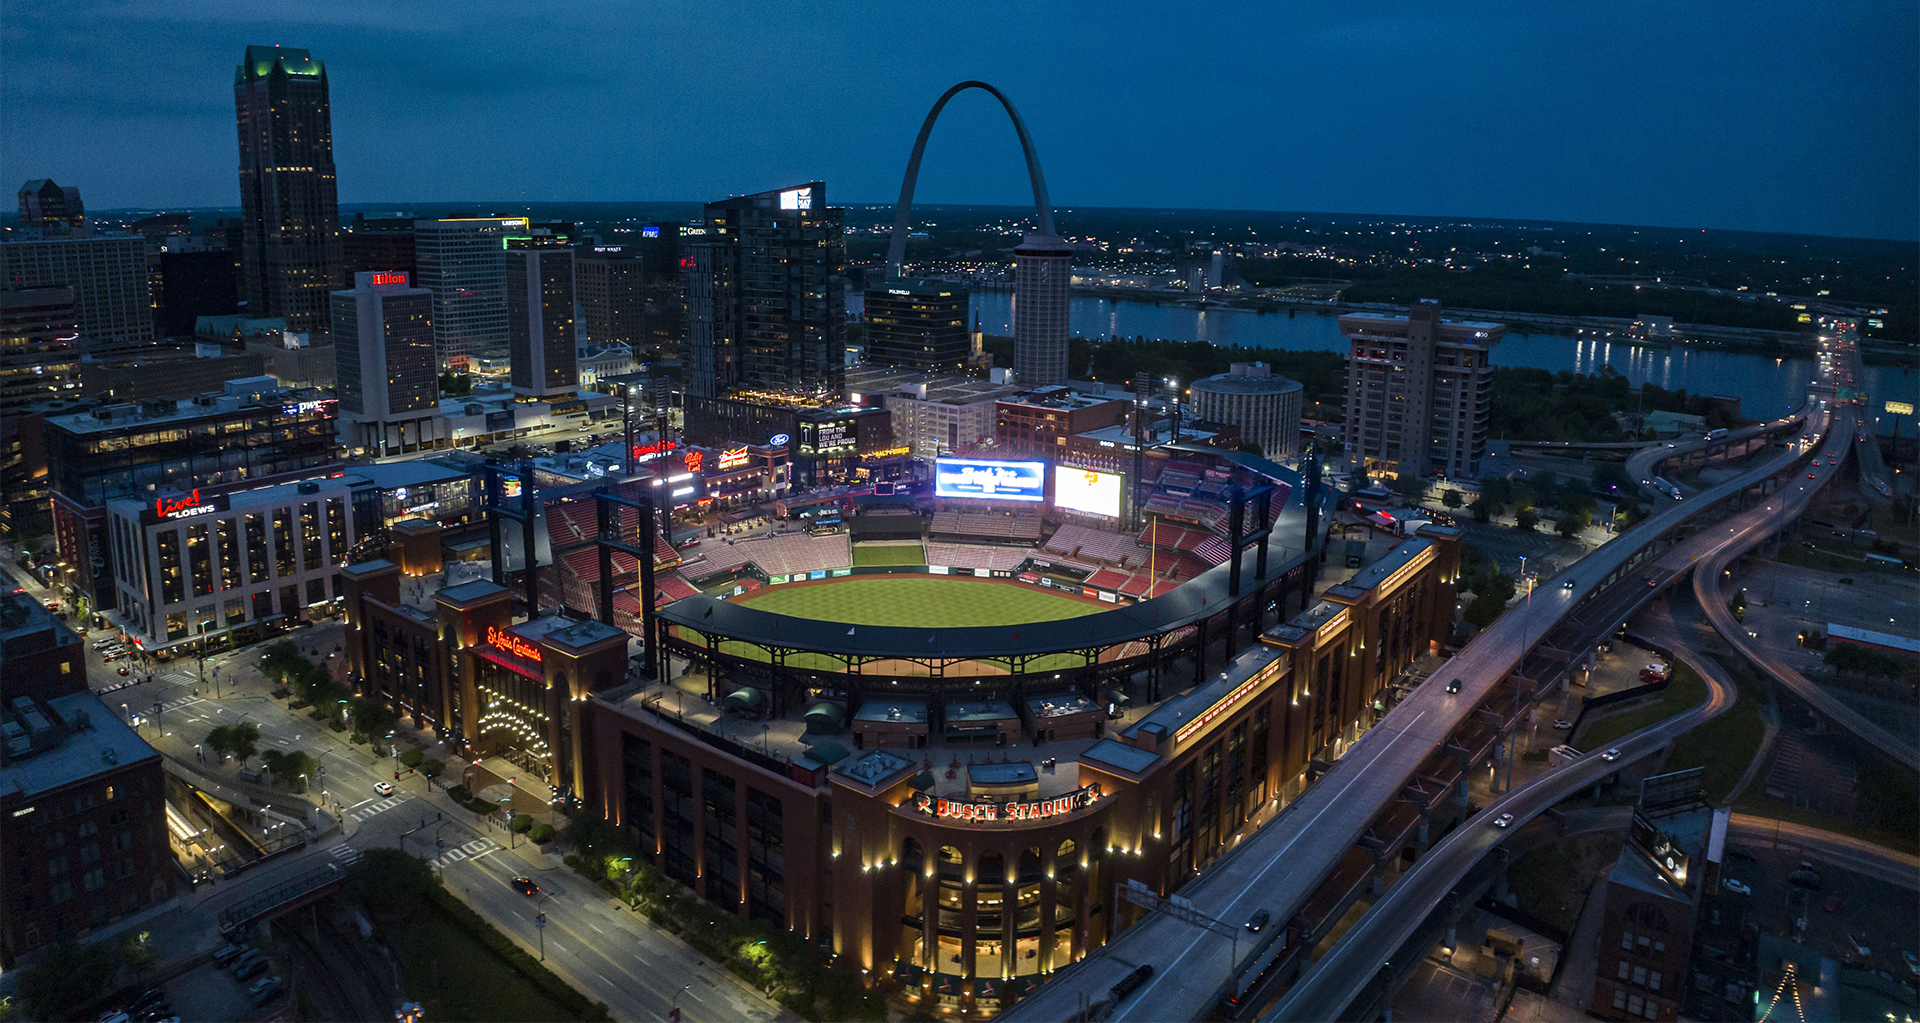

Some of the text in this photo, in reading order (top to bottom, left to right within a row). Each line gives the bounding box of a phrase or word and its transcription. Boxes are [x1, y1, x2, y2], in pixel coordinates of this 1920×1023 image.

[642, 230, 659, 238] KPMG
[373, 272, 406, 285] Hilton
[299, 400, 322, 413] pwc
[819, 437, 856, 448] WE'RE PROUD
[1063, 460, 1082, 468] WORLD
[156, 488, 200, 517] Live!
[175, 504, 215, 518] LOEWS
[495, 631, 513, 651] Louis
[512, 637, 542, 661] Cardinals
[936, 794, 1086, 821] BUSCH STADIUM
